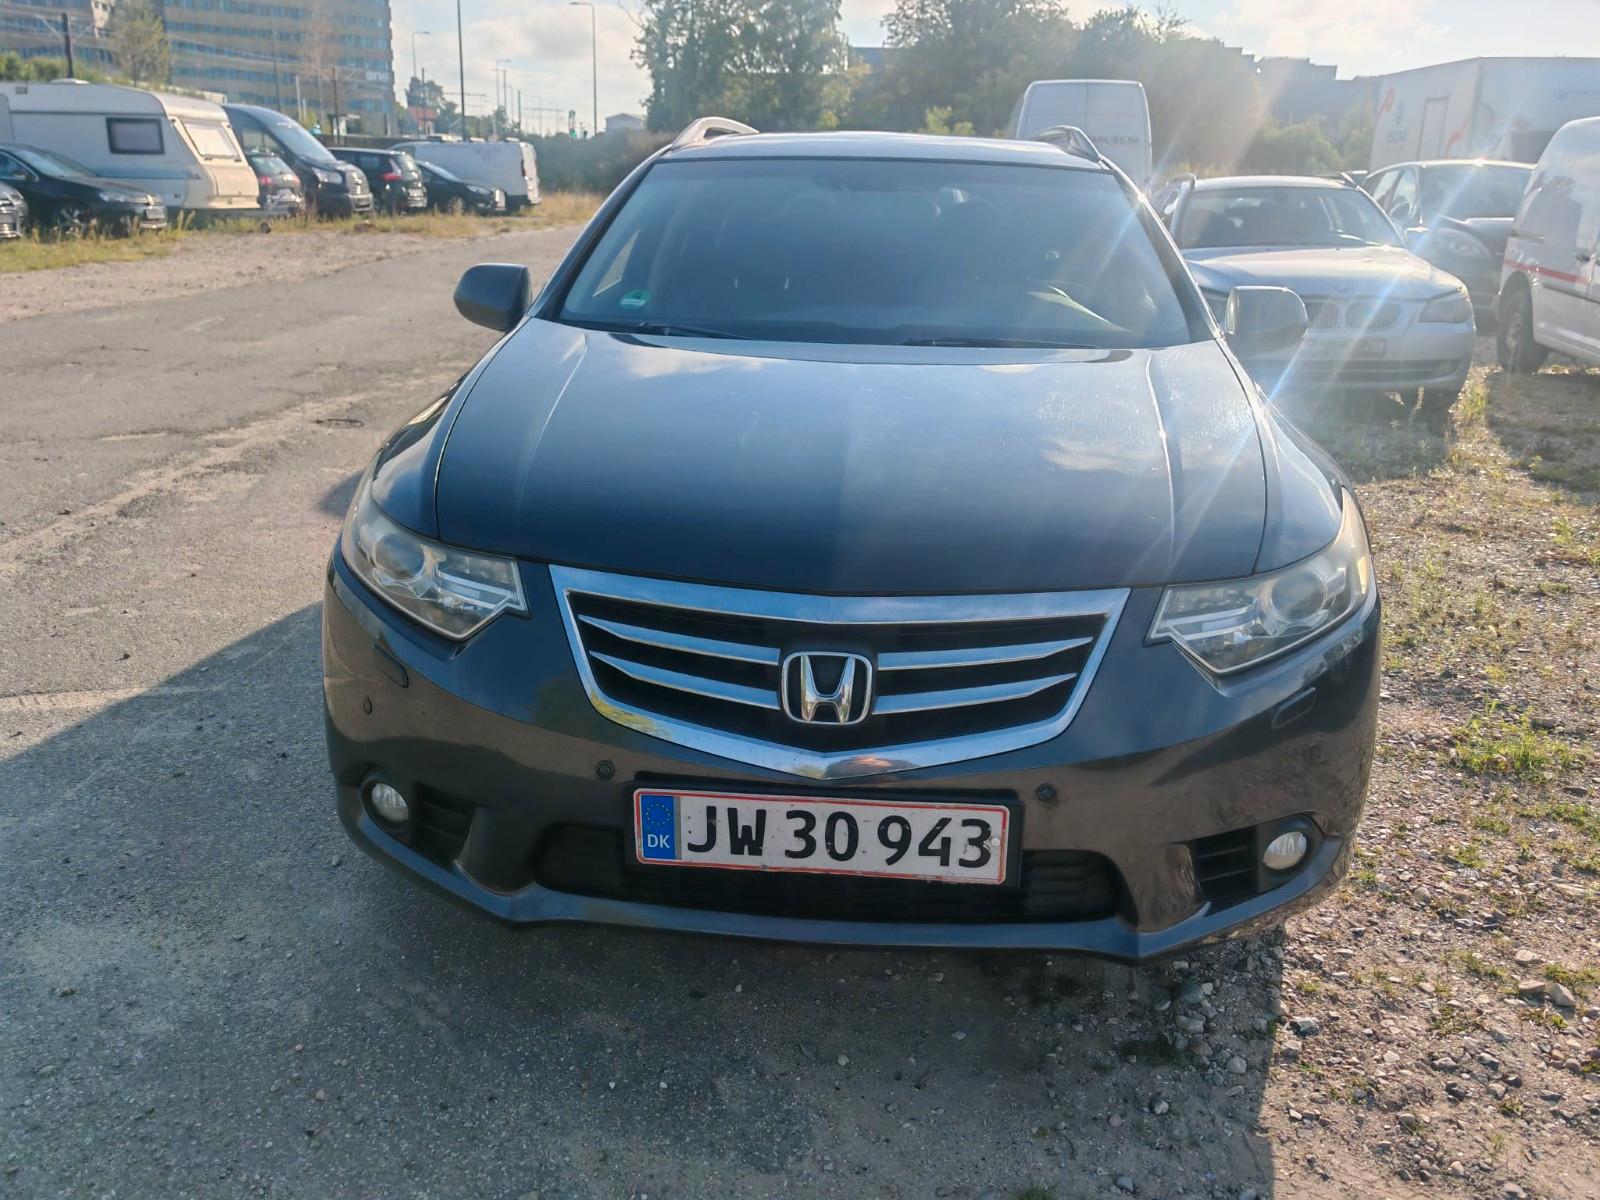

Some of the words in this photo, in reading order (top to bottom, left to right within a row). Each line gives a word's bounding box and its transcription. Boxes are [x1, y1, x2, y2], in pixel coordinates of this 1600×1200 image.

[647, 833, 671, 849] DK
[687, 805, 767, 856] JW
[784, 809, 860, 862] 30
[877, 814, 992, 869] 943
